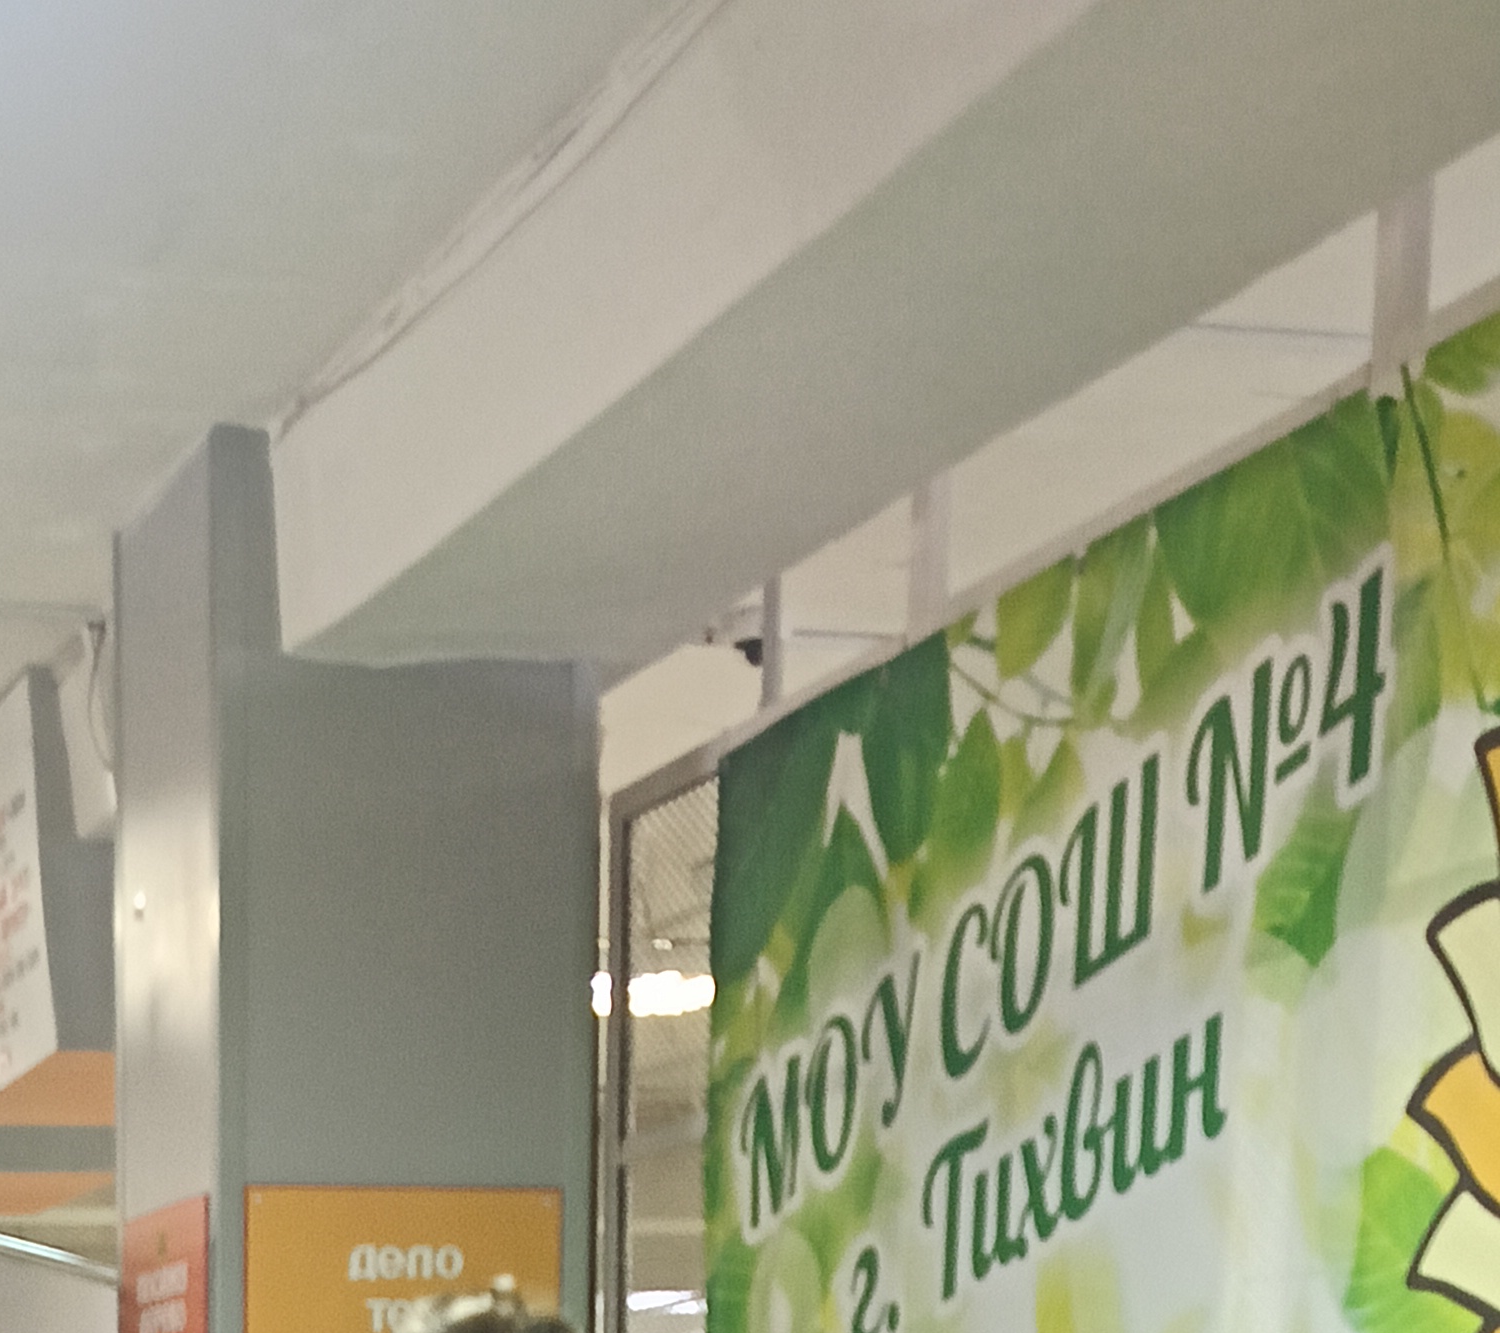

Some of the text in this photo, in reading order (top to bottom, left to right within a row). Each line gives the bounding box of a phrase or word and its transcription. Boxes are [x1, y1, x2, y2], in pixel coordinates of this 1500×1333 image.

[740, 567, 1386, 1229] МОУ СОШ №4
[923, 1013, 1228, 1300] Тихвин
